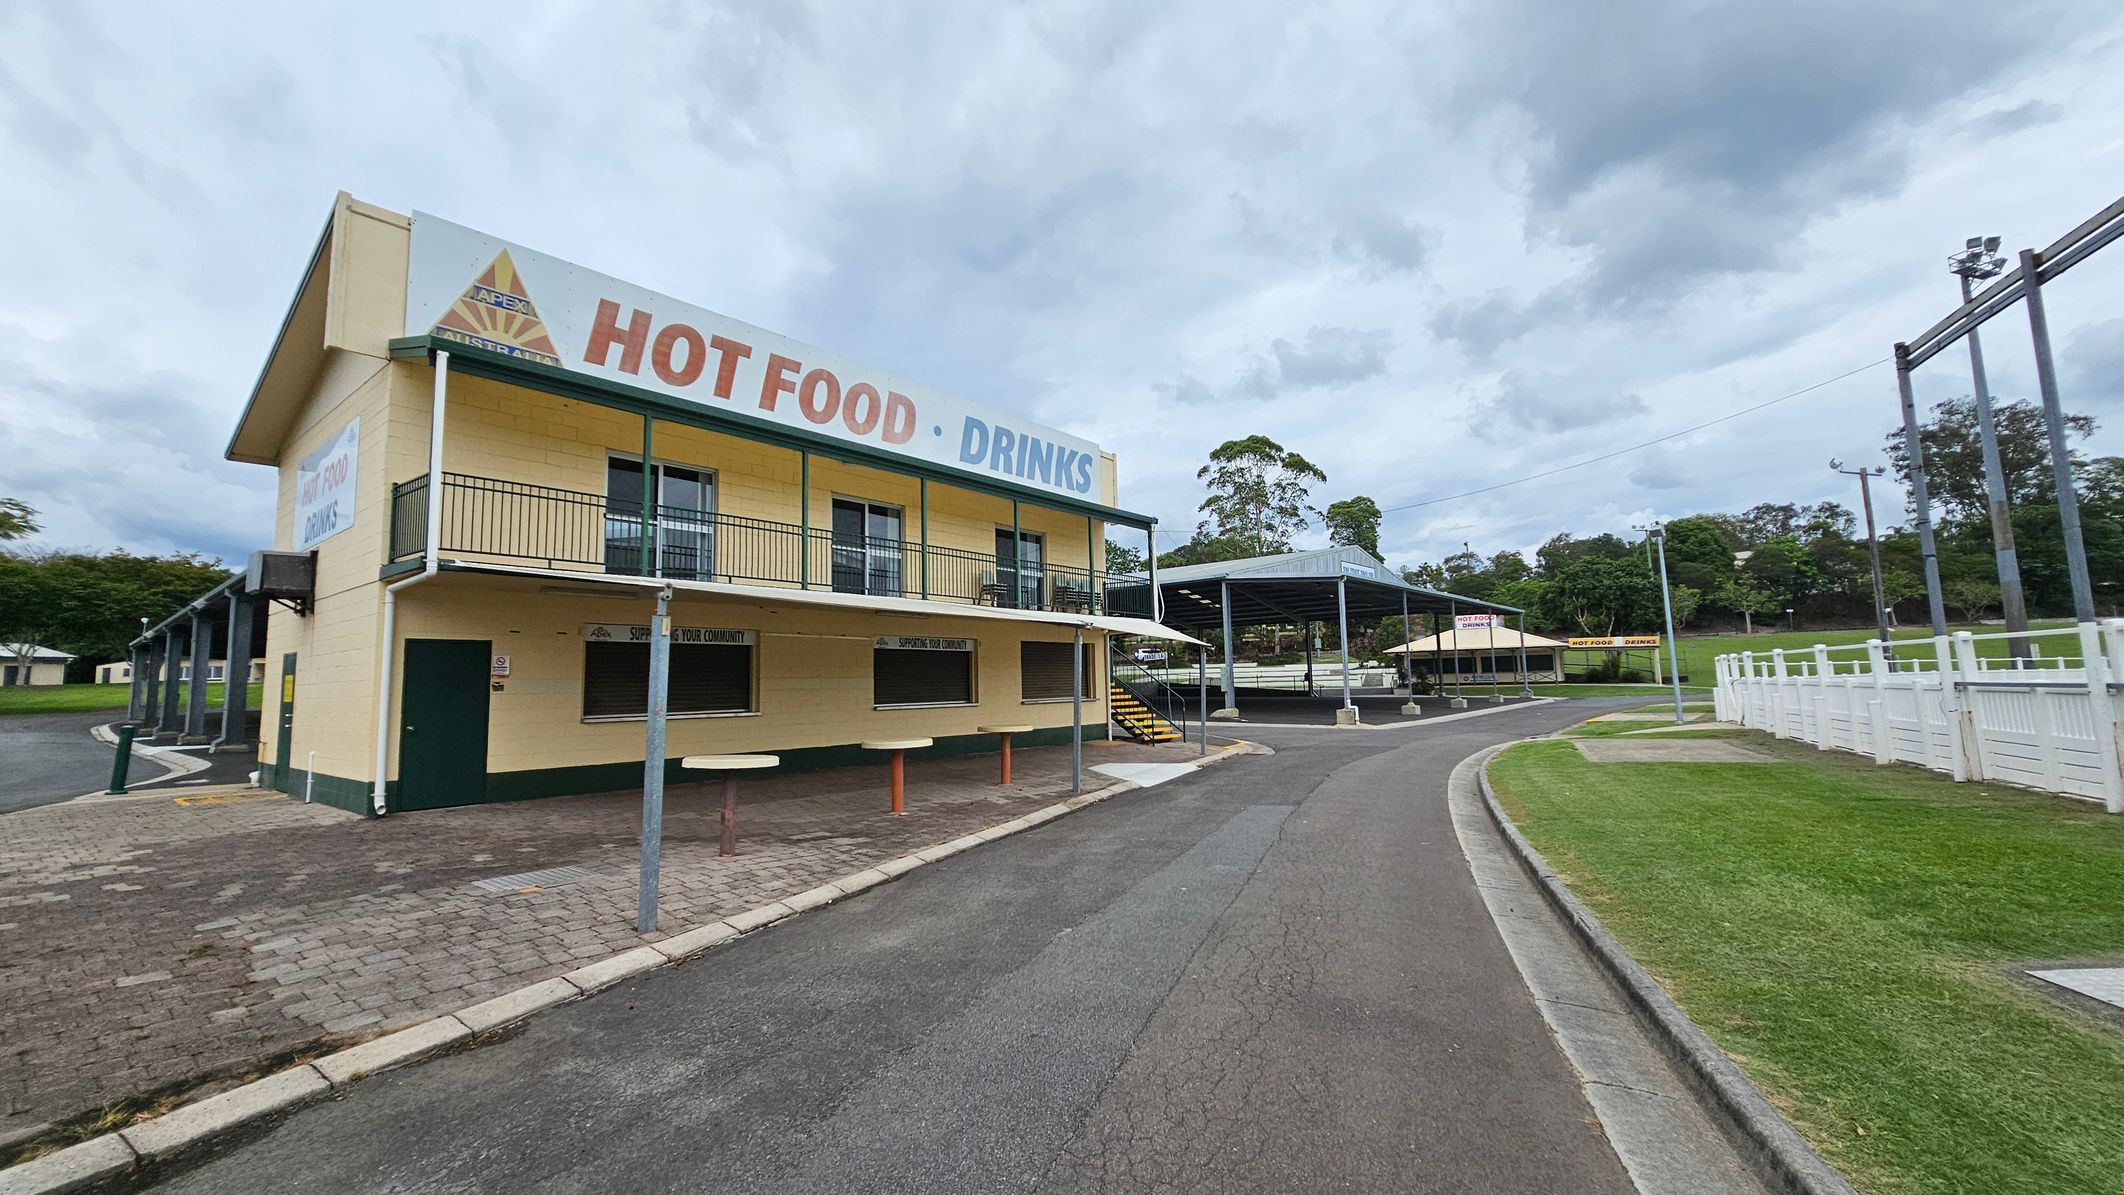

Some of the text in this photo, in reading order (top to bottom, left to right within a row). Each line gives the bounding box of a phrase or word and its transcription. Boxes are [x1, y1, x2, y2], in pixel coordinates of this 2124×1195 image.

[478, 288, 528, 313] APEX
[583, 297, 1093, 494] HOT FOOD DRINKS
[303, 453, 348, 507] HOT FOOD
[304, 499, 338, 543] DRINKS
[682, 628, 701, 642] YOUR
[703, 630, 745, 644] COMMUNITY
[898, 637, 967, 650] SUPPORTING YOUR COMMUNITY
